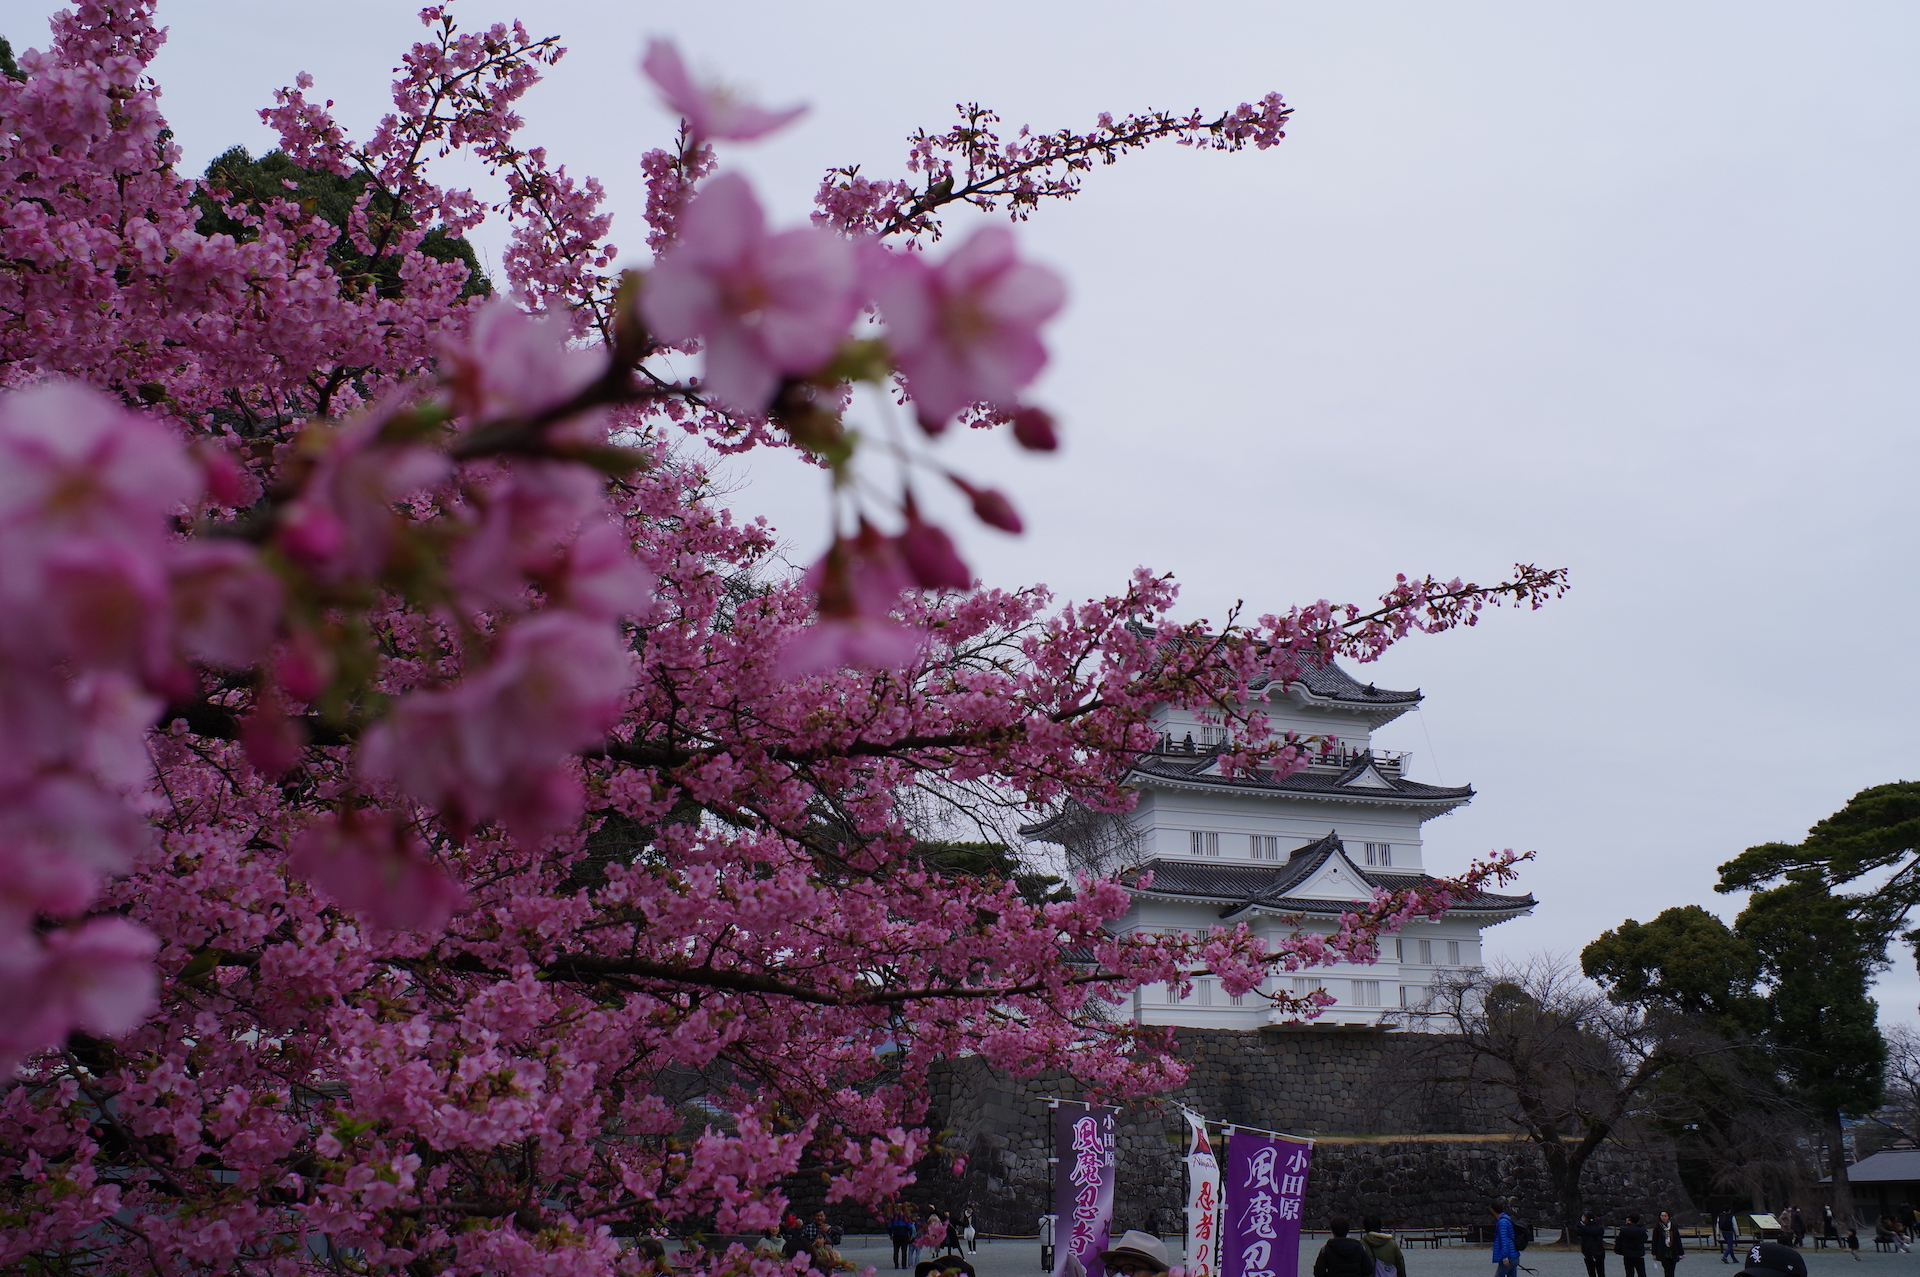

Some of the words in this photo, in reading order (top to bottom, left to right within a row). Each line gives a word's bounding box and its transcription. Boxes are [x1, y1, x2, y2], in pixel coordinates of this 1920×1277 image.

[1102, 1113, 1115, 1168] 小田原
[1280, 1149, 1308, 1221] 小田原
